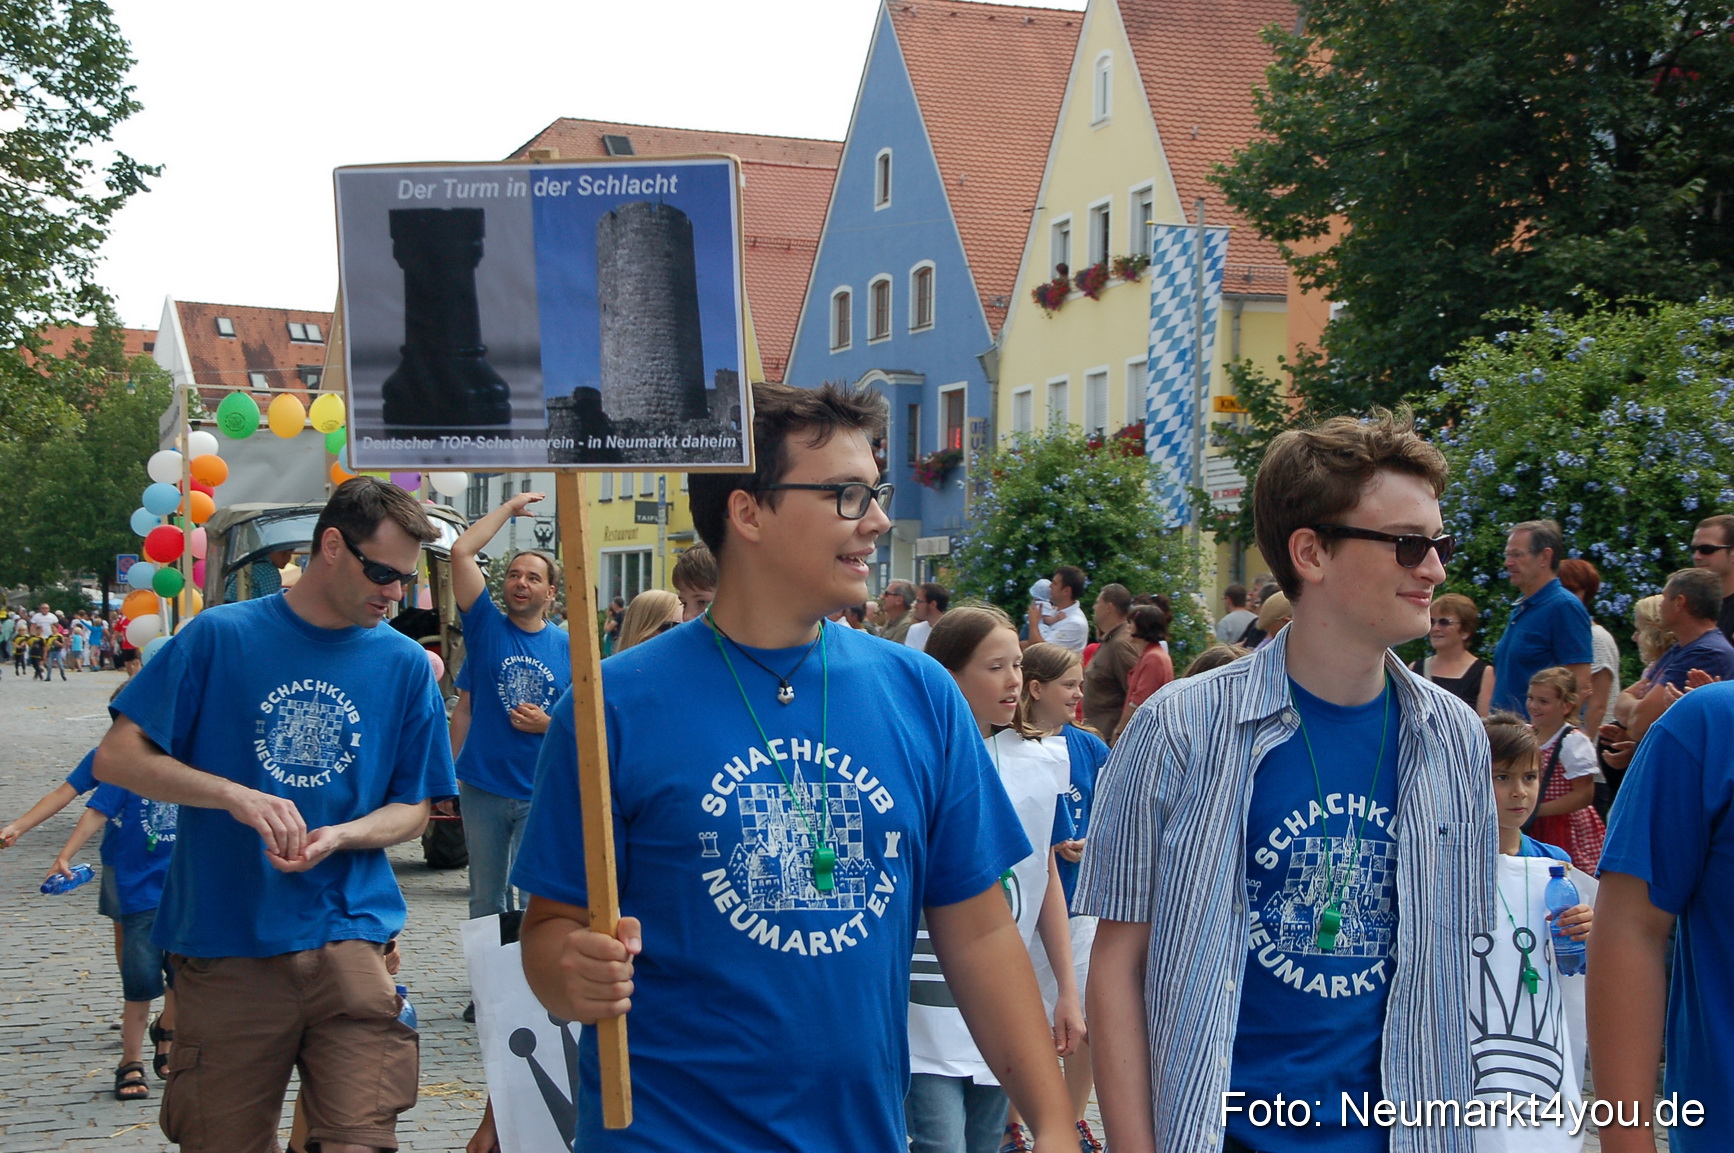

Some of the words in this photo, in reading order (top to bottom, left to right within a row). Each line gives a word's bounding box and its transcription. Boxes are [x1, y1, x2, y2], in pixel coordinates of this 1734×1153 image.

[398, 179, 436, 200] Der
[443, 178, 499, 199] Turm
[506, 177, 527, 197] in
[533, 176, 571, 197] der
[577, 173, 679, 196] Schlacht
[362, 435, 437, 450] Deutscher
[440, 434, 575, 450] TOP-Schachverein
[587, 434, 602, 449] in
[606, 434, 678, 449] Neumarkt
[681, 433, 737, 448] daheim
[604, 525, 639, 542] Restaurant
[260, 678, 361, 725] SCHACHKLUB
[253, 738, 332, 788] NEUMARKT
[333, 750, 356, 774] E.V.
[701, 737, 895, 818] SCHACHKLUB
[702, 867, 869, 957] NEUMARKT
[866, 870, 898, 919] E.V.
